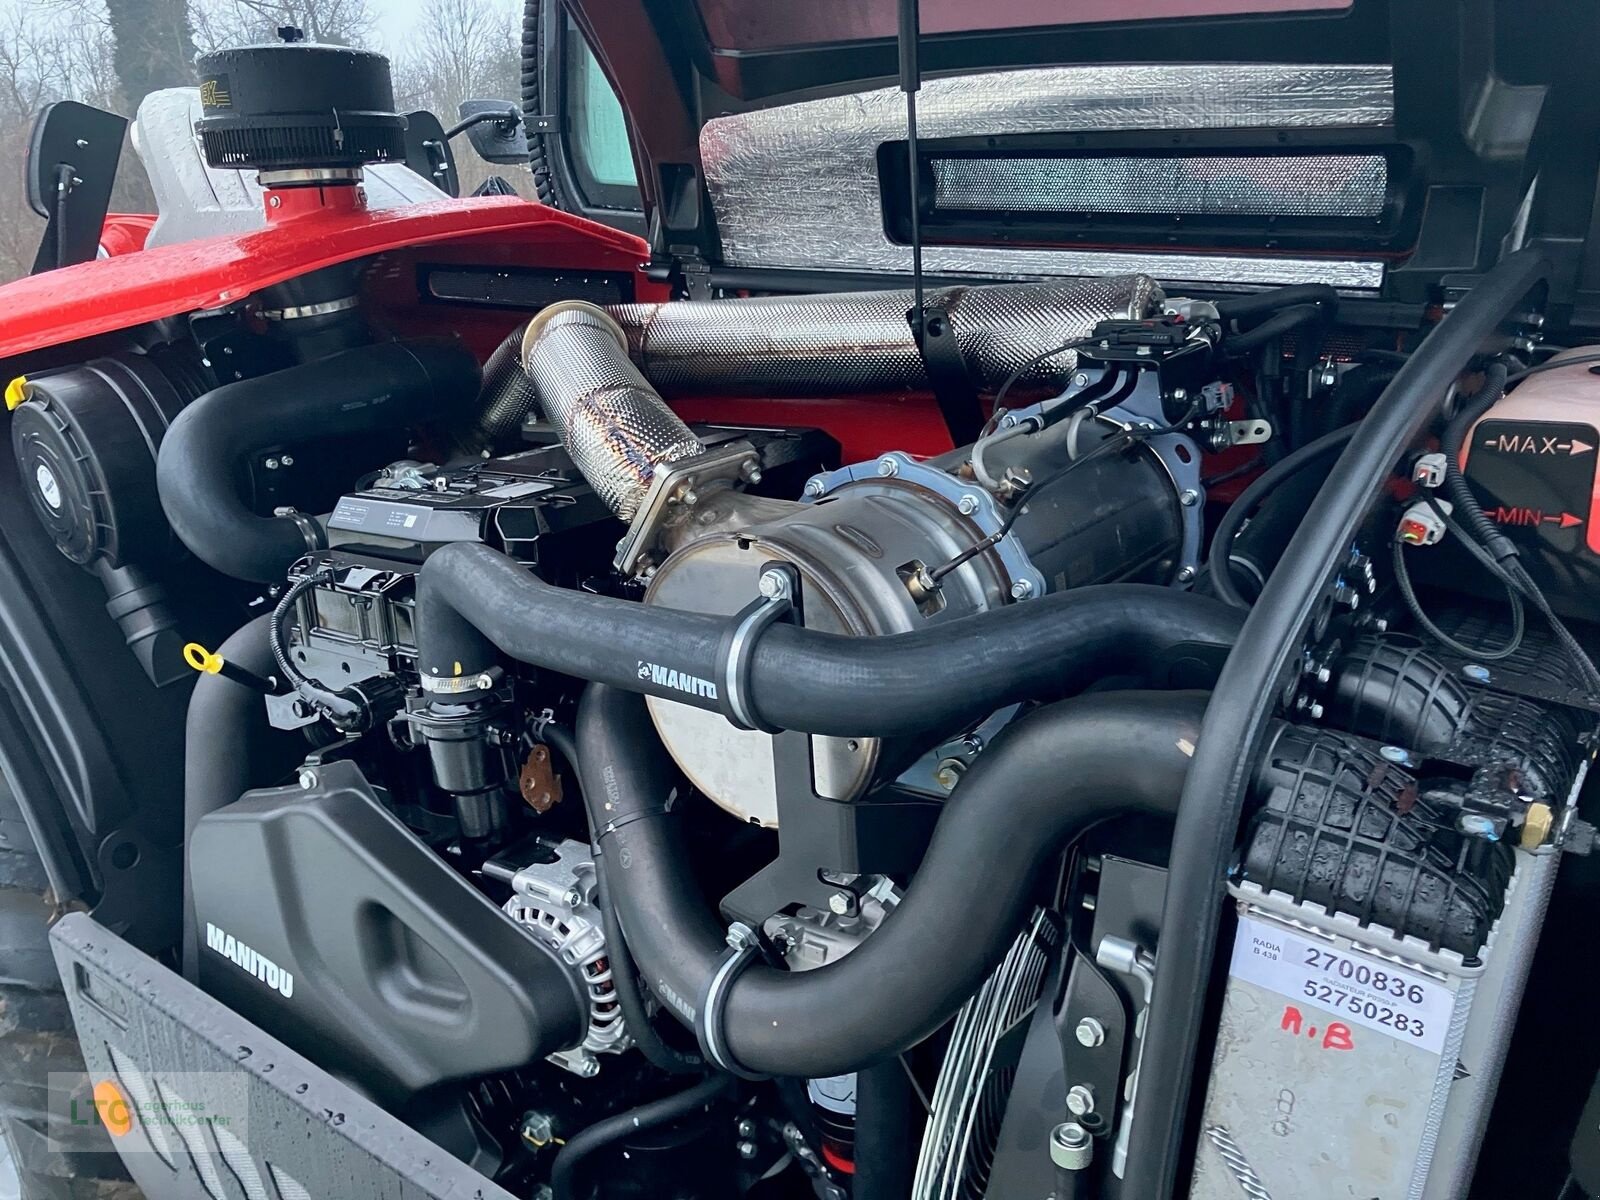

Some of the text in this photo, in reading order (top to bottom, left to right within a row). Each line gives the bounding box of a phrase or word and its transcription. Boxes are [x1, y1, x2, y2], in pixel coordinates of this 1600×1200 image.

[1498, 434, 1557, 454] MAX
[1497, 507, 1542, 525] MIN
[206, 921, 294, 998] MANITOU
[1252, 937, 1281, 953] RADIA
[1303, 947, 1425, 1005] 2700836
[1303, 979, 1426, 1039] 52750283
